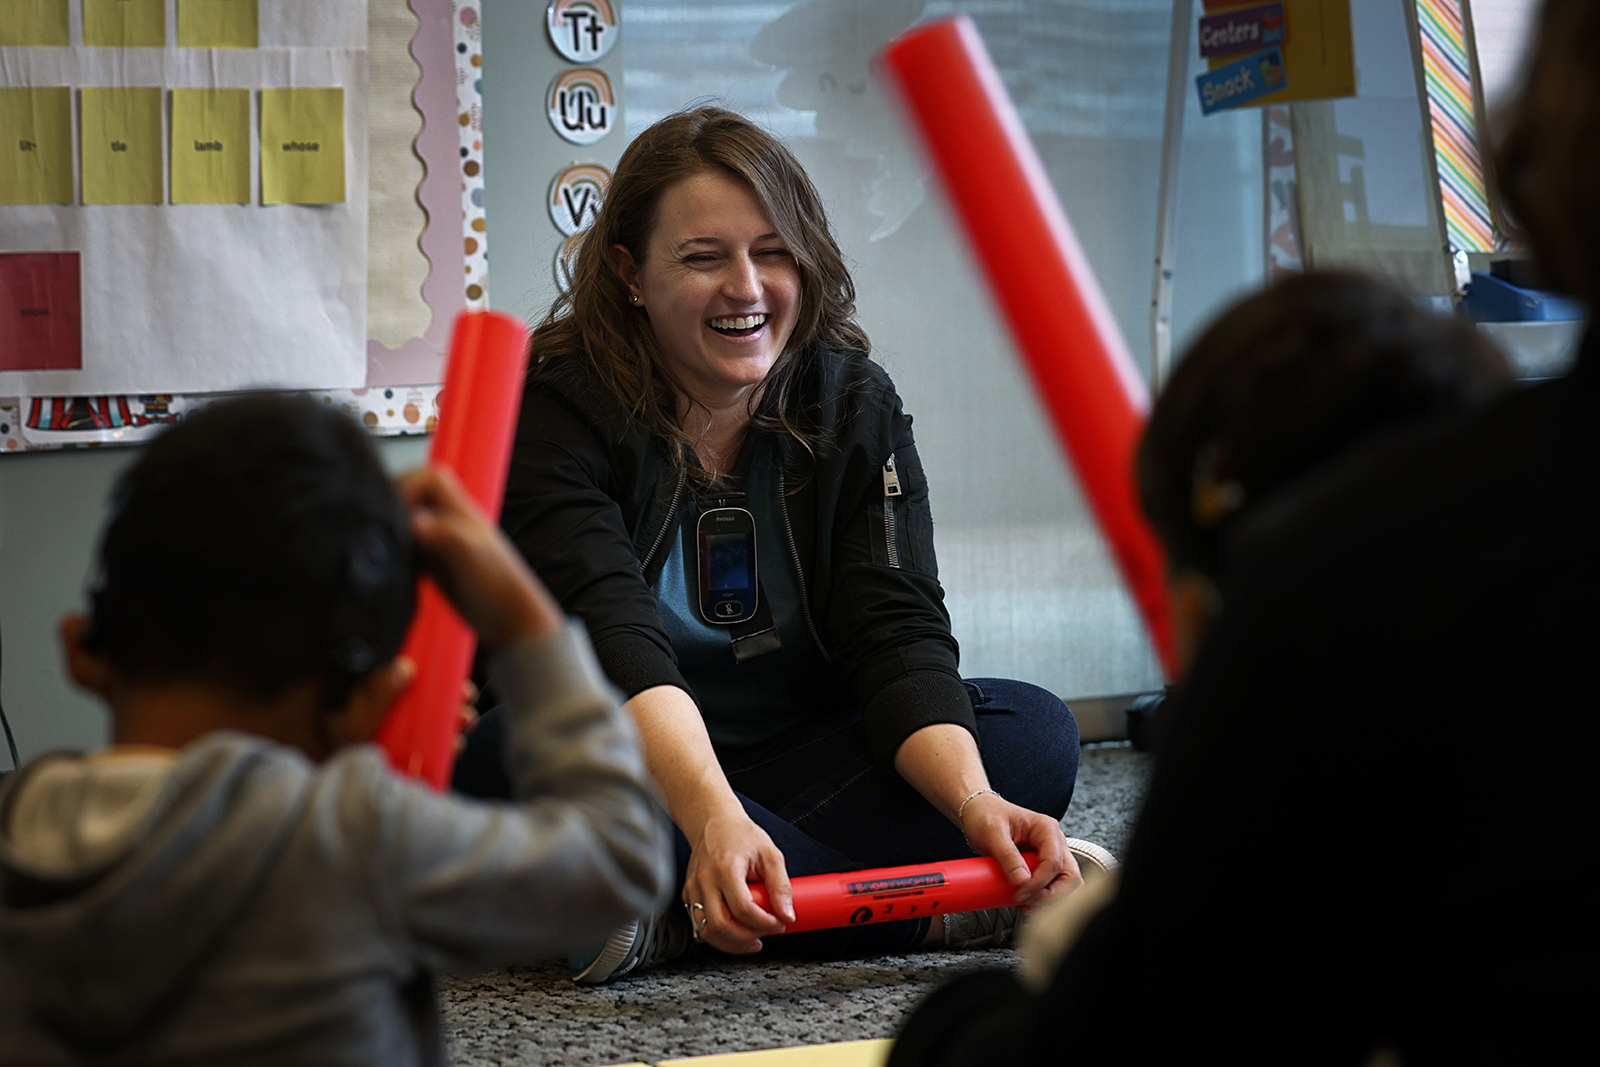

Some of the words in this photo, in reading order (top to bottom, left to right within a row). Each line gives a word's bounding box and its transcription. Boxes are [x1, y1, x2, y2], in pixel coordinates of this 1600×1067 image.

[562, 11, 603, 52] Tt
[1201, 20, 1260, 48] Centers
[1203, 65, 1255, 107] Snack
[559, 90, 606, 131] Uu
[194, 140, 223, 152] lamb
[282, 140, 320, 152] whose
